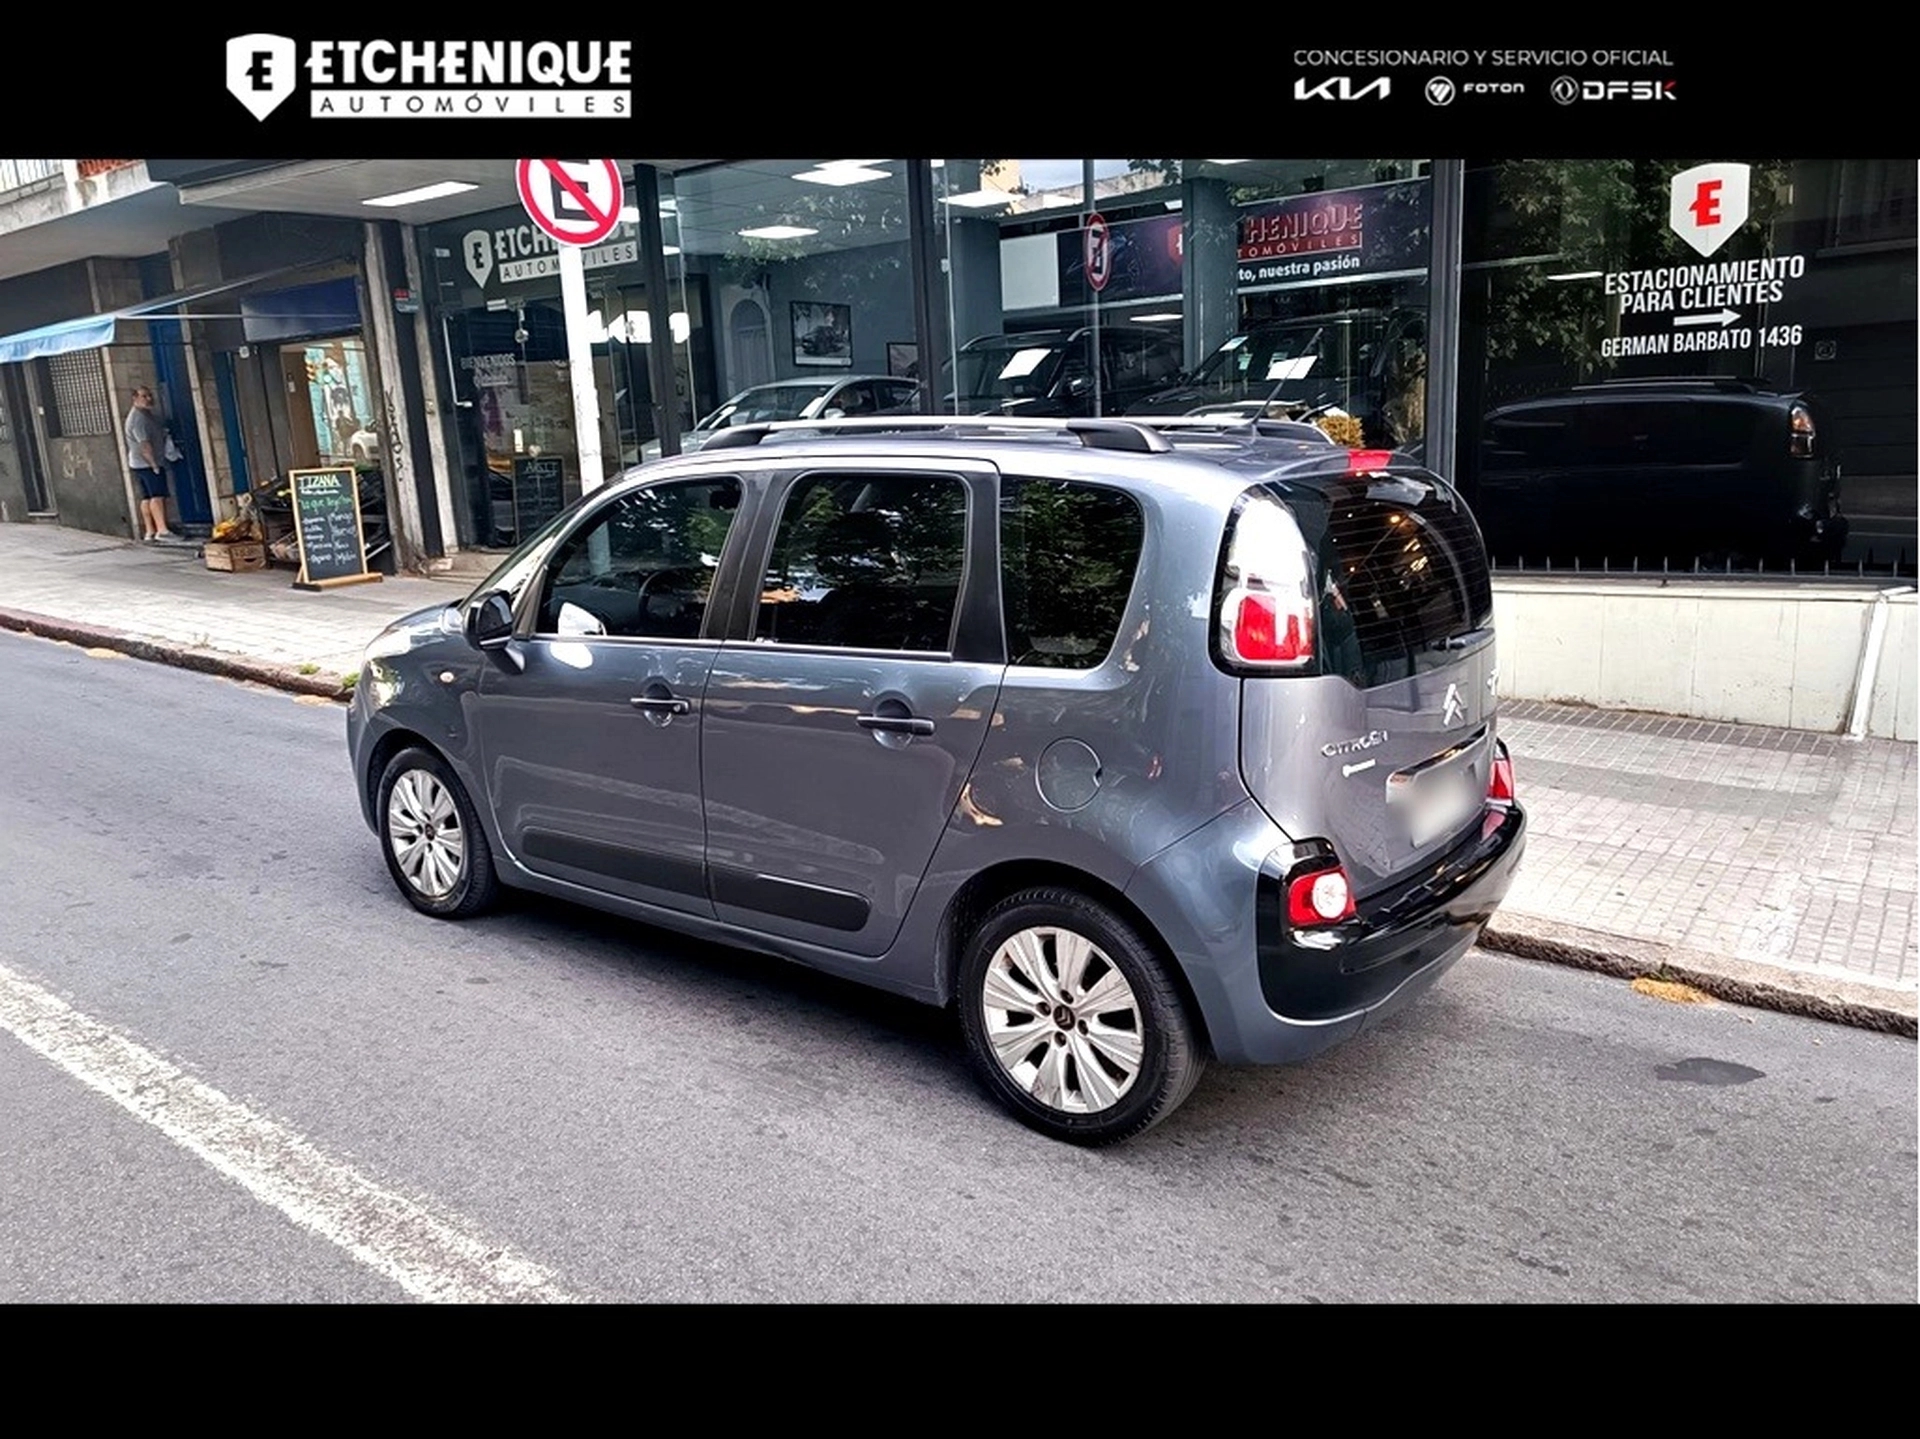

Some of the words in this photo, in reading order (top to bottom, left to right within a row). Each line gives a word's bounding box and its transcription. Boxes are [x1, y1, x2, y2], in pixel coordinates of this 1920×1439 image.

[1259, 262, 1311, 278] nuestra
[1313, 254, 1360, 276] pasión
[1604, 255, 1805, 295] ESTACIONAMIENTO
[1620, 289, 1674, 315] PARA
[1680, 279, 1784, 310] CLIENTES
[1601, 333, 1669, 357] GERMAN
[1673, 328, 1751, 353] BARBATO
[1758, 324, 1803, 348] 1436
